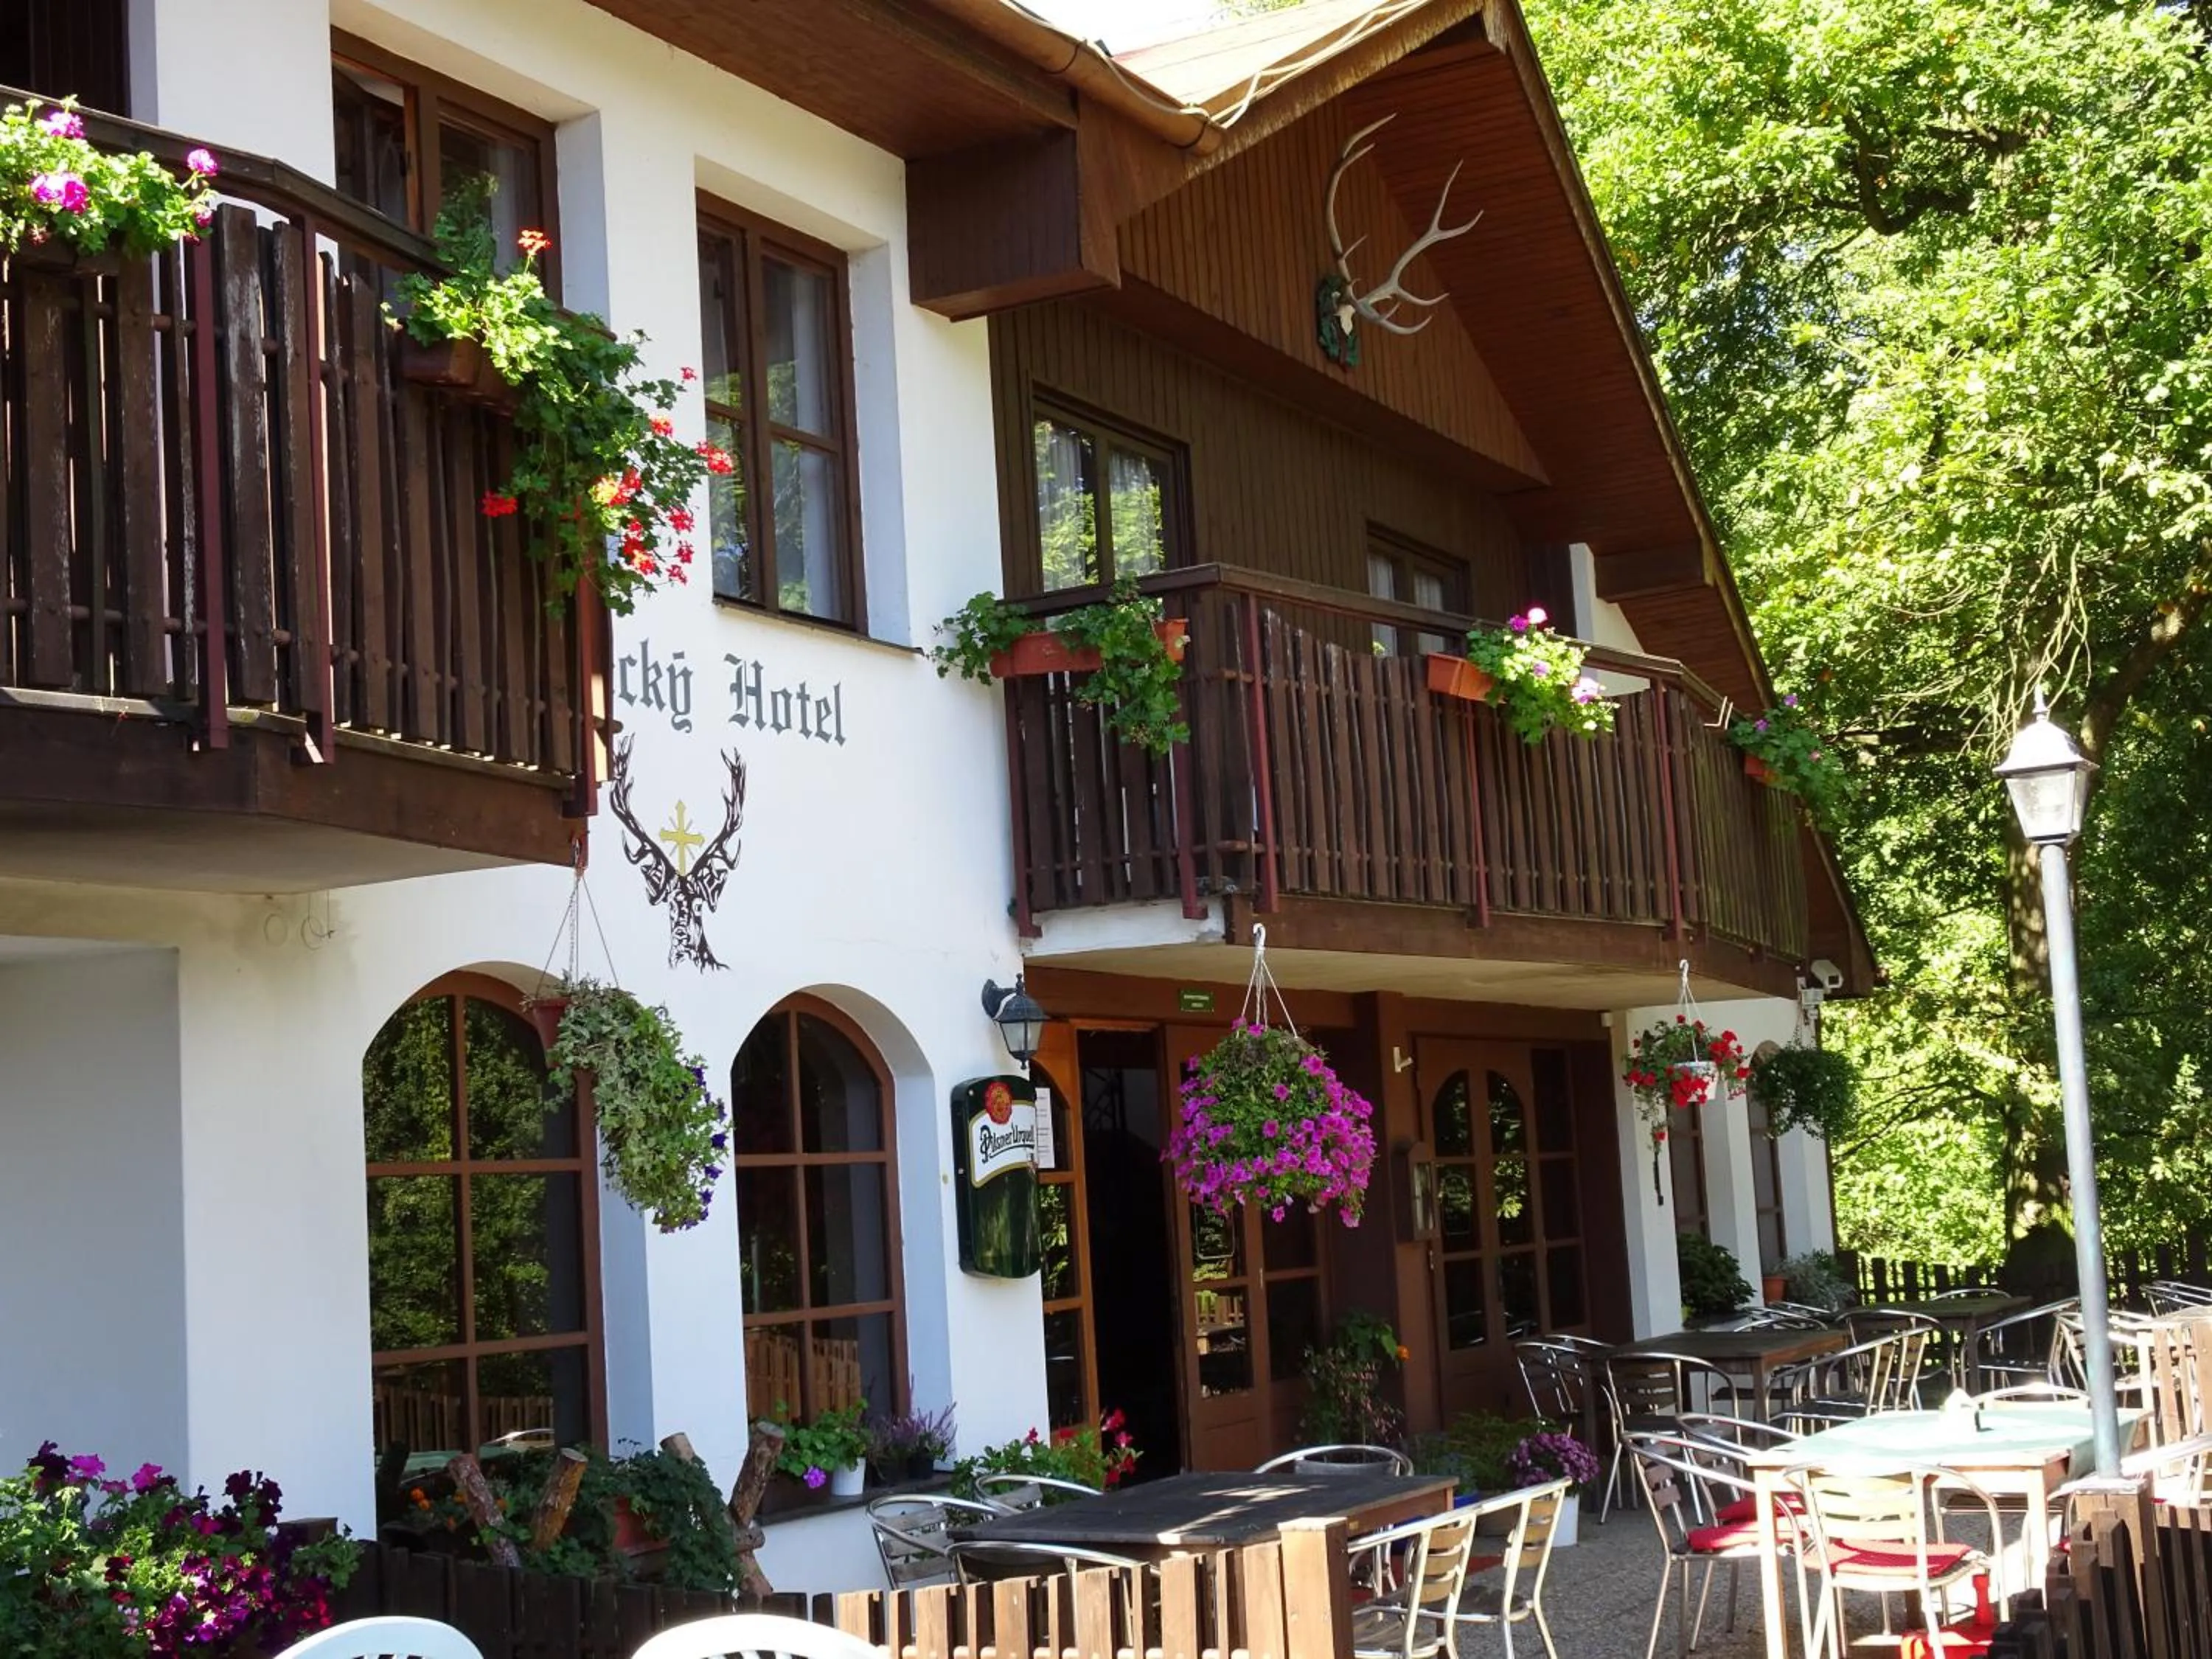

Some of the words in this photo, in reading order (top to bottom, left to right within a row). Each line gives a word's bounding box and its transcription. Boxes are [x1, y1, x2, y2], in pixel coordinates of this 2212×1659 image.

[613, 637, 693, 733] cký
[723, 653, 846, 746] Hotel
[980, 1124, 1012, 1164] Pilsner
